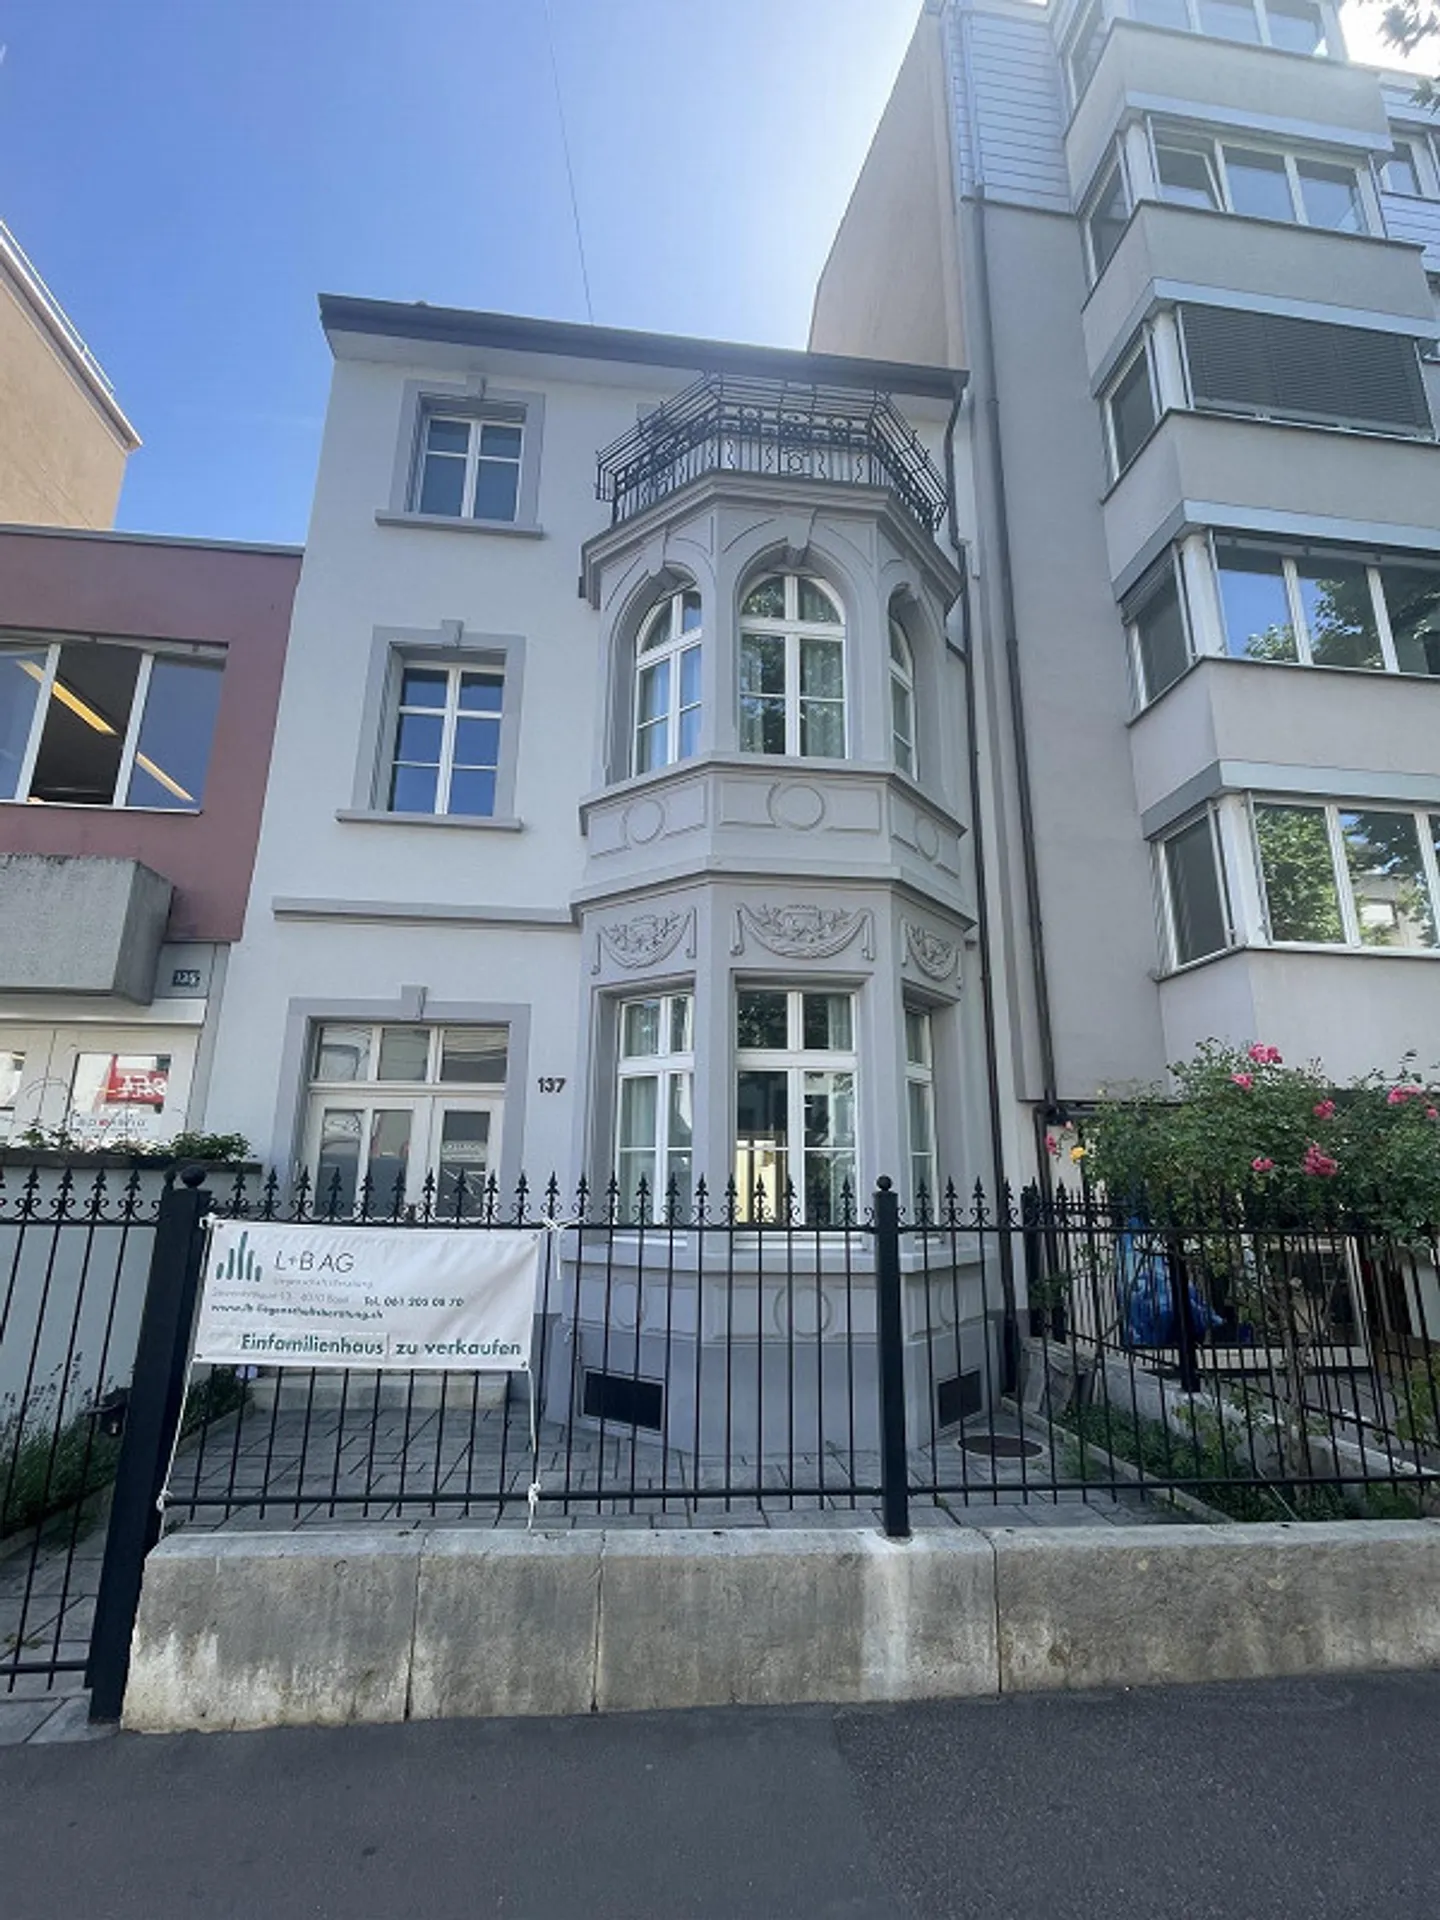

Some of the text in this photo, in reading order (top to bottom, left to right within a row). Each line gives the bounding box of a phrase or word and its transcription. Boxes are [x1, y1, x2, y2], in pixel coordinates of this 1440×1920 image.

[537, 1077, 566, 1093] 137
[317, 1252, 355, 1273] AG
[240, 1333, 521, 1355] Einfamilienhaus zu verkaufen
